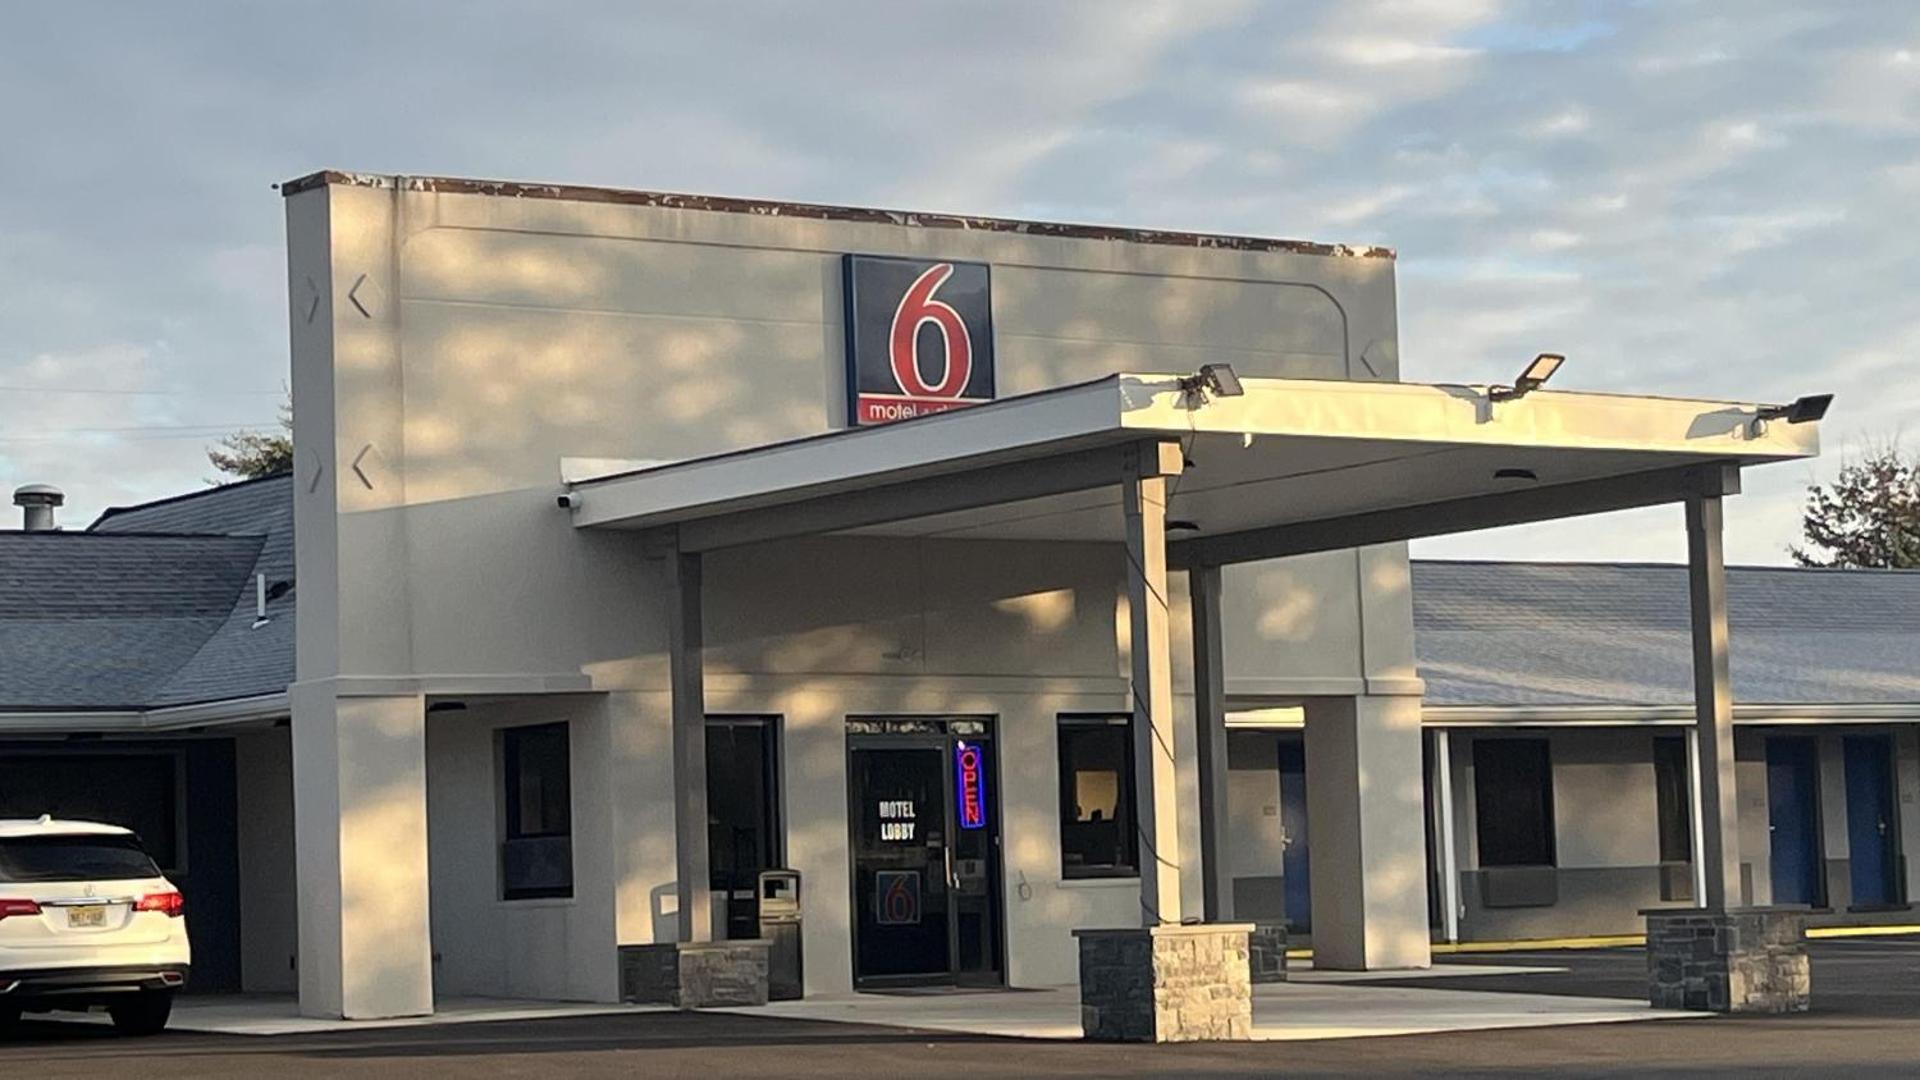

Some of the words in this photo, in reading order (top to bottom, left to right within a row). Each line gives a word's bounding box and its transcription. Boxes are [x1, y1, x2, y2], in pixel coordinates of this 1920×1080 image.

[889, 263, 972, 398] 6
[870, 403, 917, 420] motel
[961, 751, 979, 824] OPEN
[879, 800, 916, 818] MOTEL
[881, 822, 915, 840] LOBBY
[885, 875, 915, 922] 6
